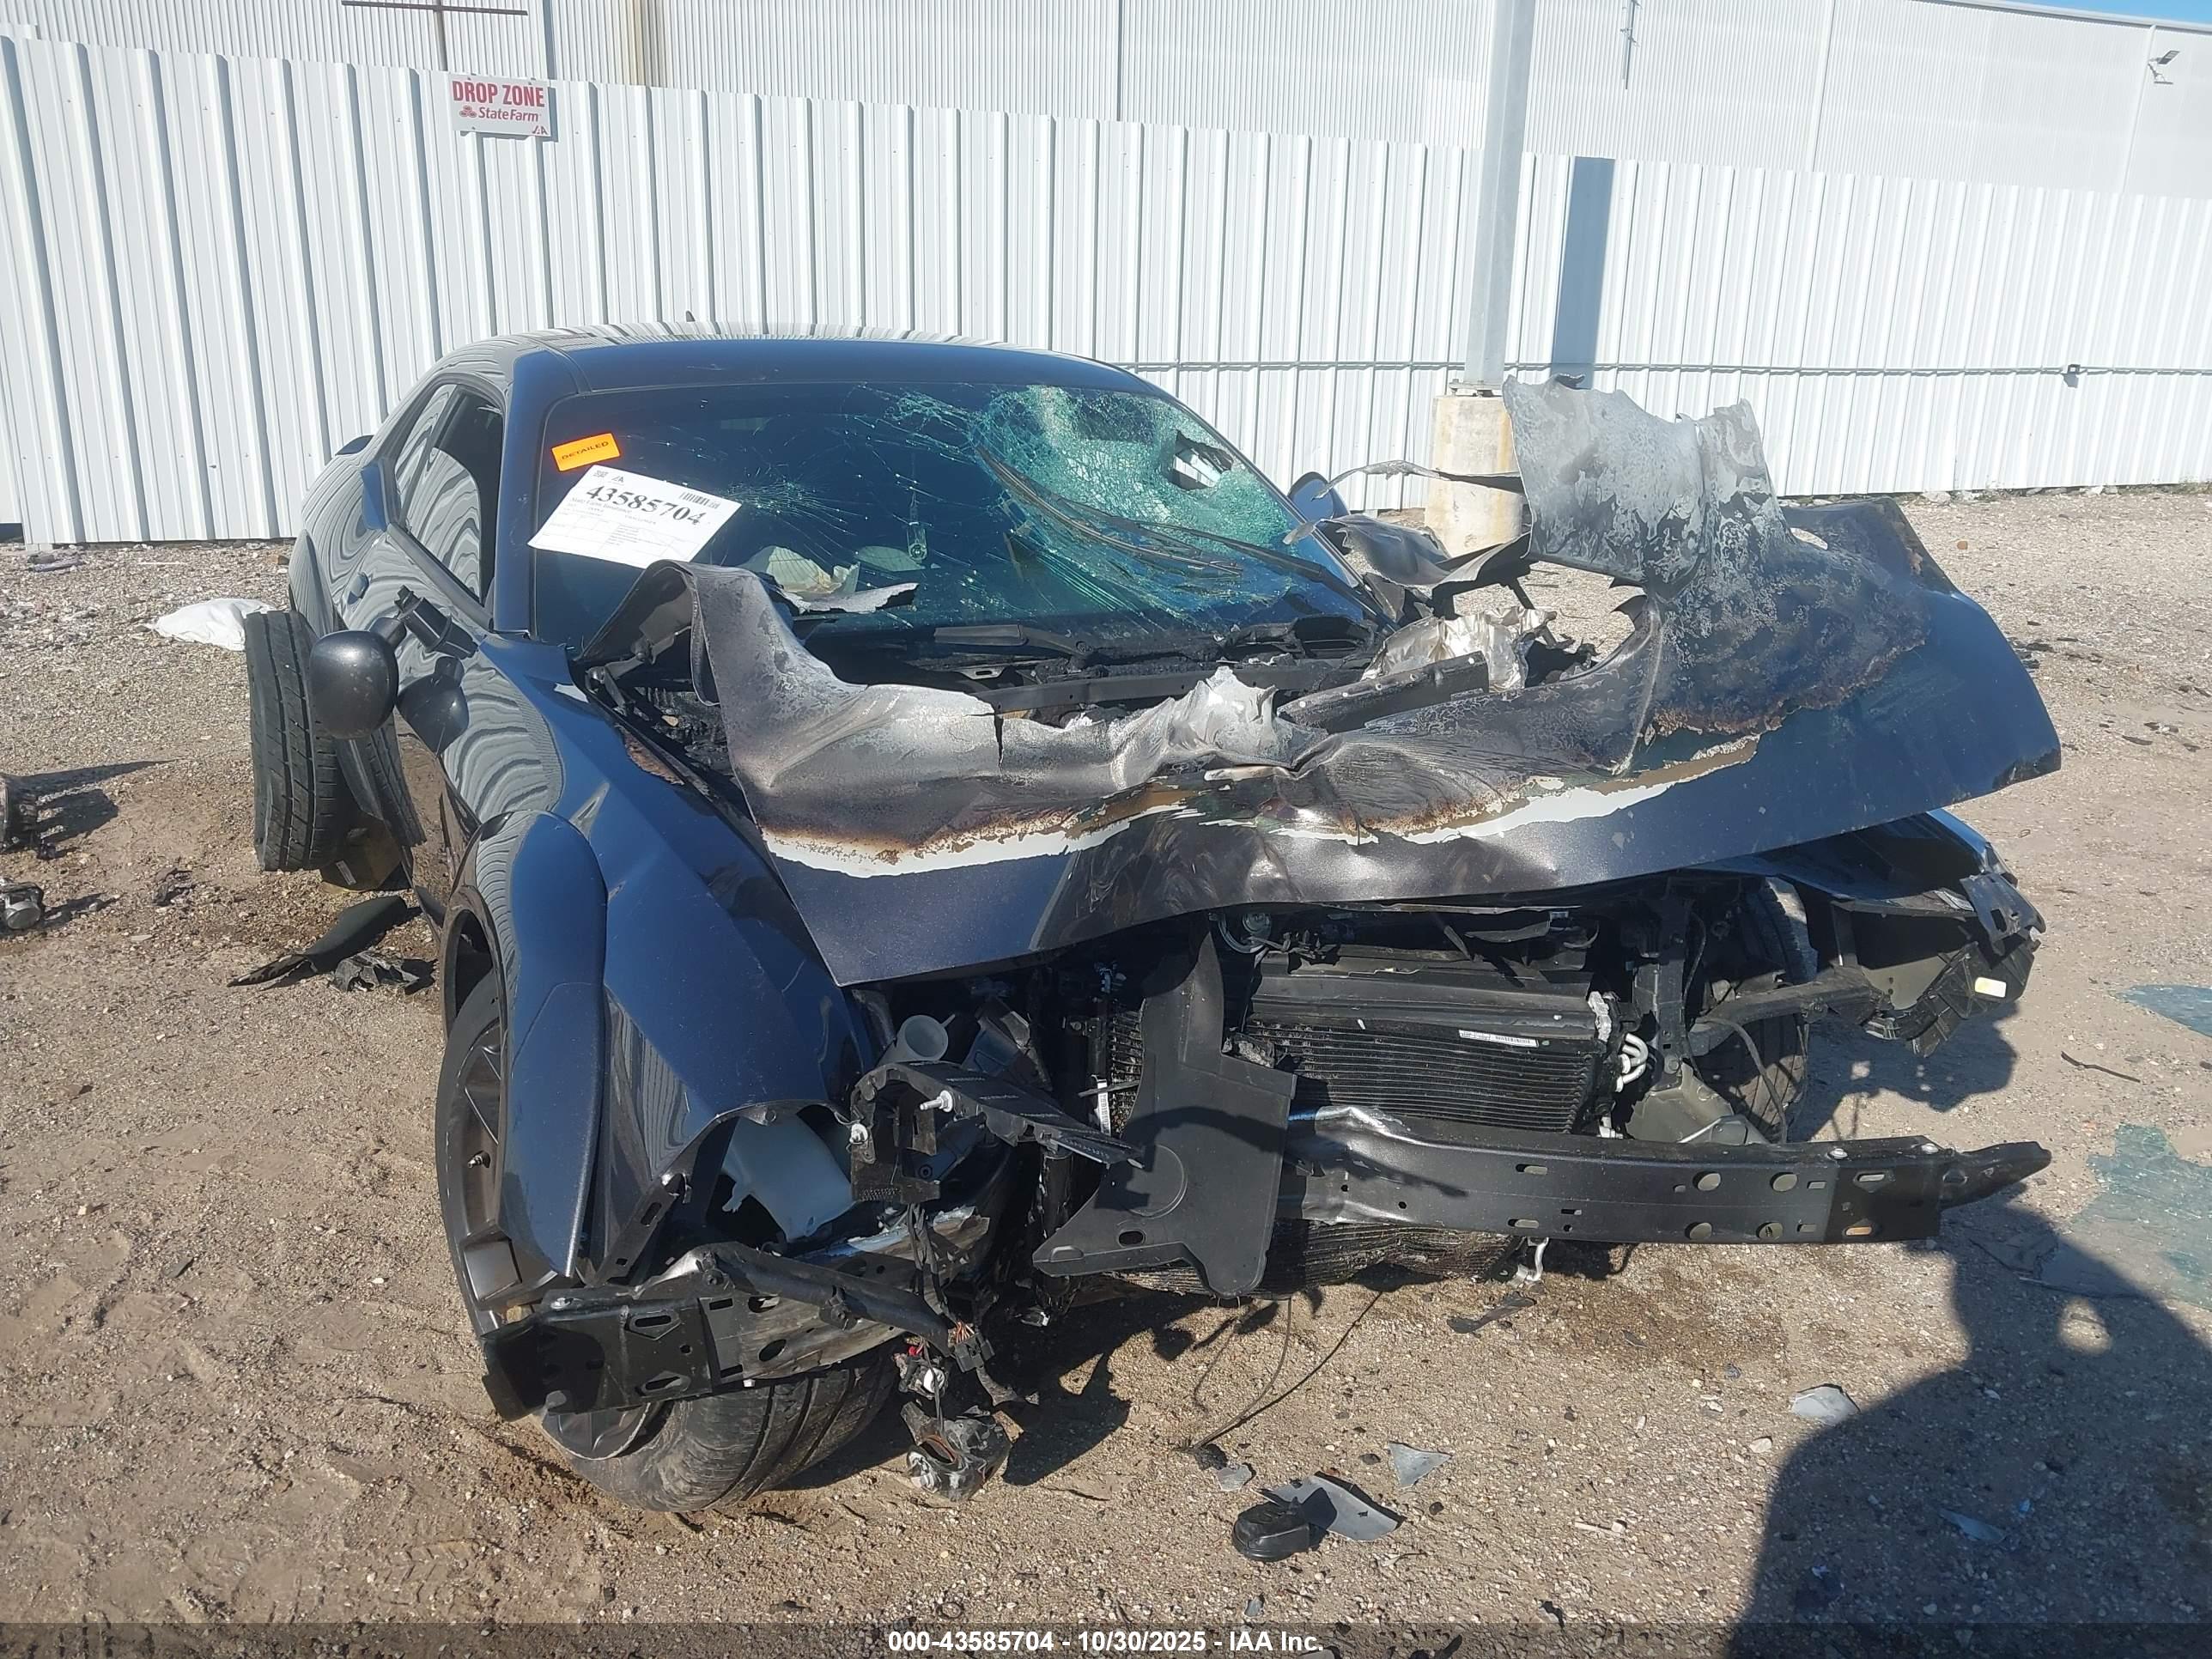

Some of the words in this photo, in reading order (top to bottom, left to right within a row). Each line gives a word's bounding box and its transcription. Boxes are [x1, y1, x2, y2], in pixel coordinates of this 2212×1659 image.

[452, 80, 498, 104] DROP
[502, 84, 545, 107] ZONE
[562, 441, 610, 460] DETAILED
[586, 485, 707, 526] 43585704
